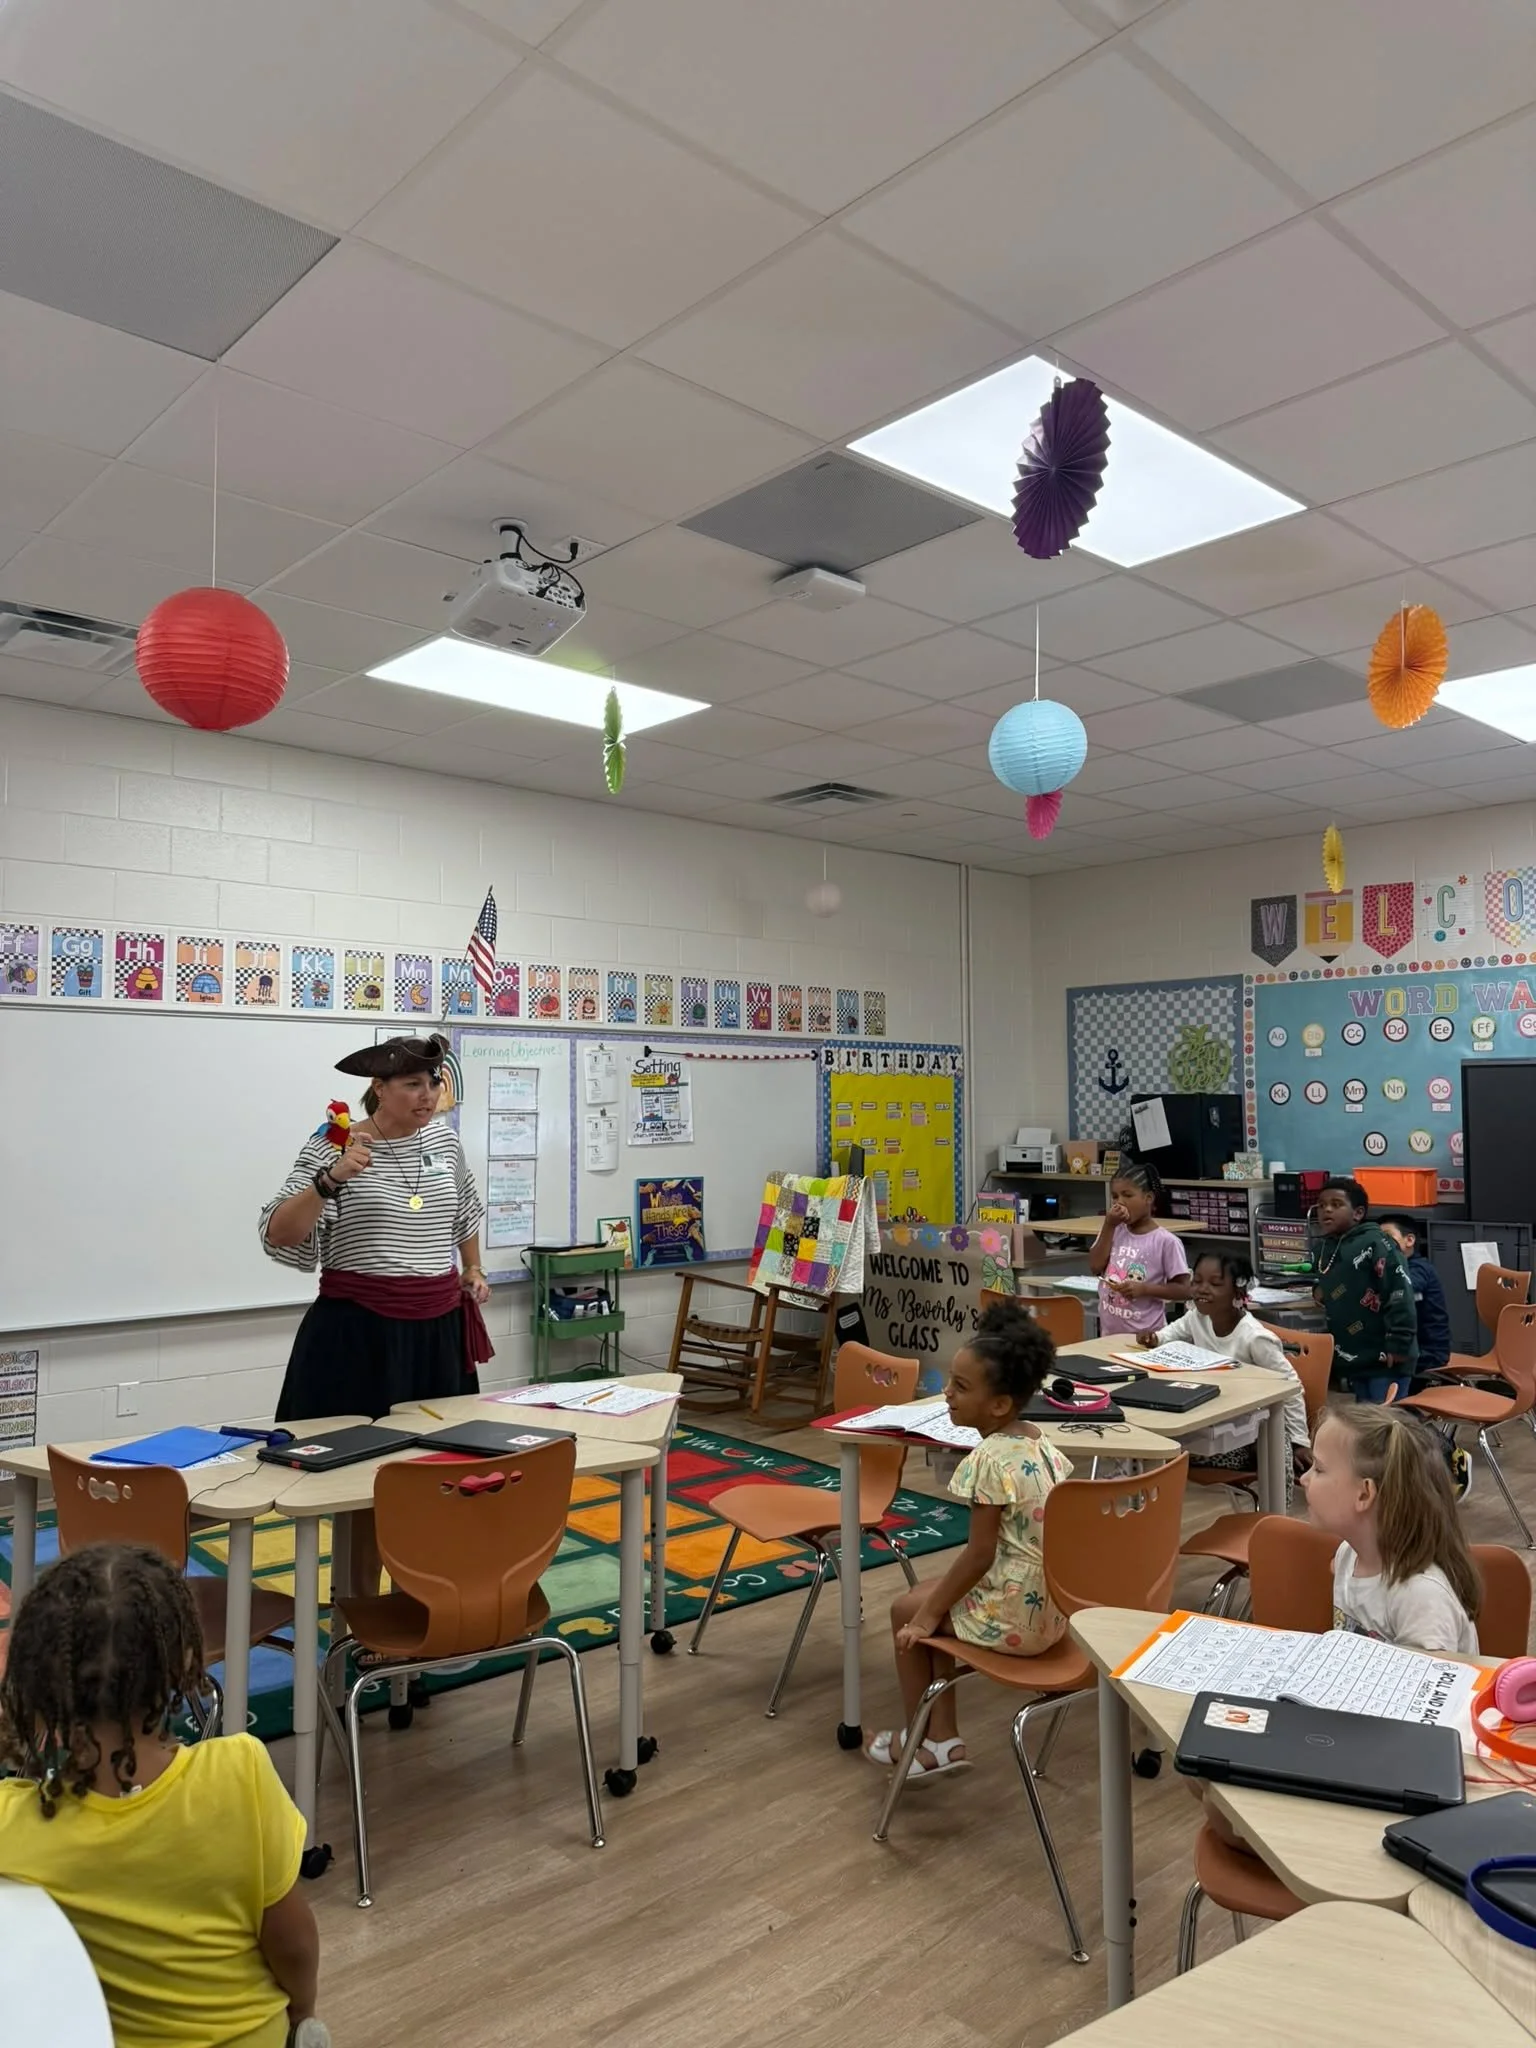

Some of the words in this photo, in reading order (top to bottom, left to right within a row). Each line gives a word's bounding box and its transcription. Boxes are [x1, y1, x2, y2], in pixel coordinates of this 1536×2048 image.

[62, 936, 94, 957] Gg
[125, 940, 155, 961] Hh
[194, 945, 208, 964] Ii
[251, 951, 268, 968] Jj
[301, 955, 326, 973] Kk
[357, 958, 372, 975] Ll
[401, 961, 426, 978] Mm
[449, 965, 470, 981] Nn
[493, 968, 513, 984] Oo
[536, 971, 553, 987] Pp
[11, 986, 27, 994] Fish
[78, 988, 92, 997] Gift
[614, 978, 631, 993] Rr
[651, 981, 667, 995] Ss
[687, 983, 703, 998] Tt
[719, 986, 736, 1000] Uu
[751, 987, 768, 1003] Vv
[782, 991, 799, 1005] Ww
[814, 993, 826, 1006] Xx
[841, 994, 855, 1008] Yy
[1349, 984, 1459, 1018] WORD
[869, 997, 881, 1010] Zz
[1346, 1028, 1361, 1039] Cc
[1388, 1024, 1405, 1035] Dd
[1434, 1023, 1449, 1035] Ee
[1477, 1022, 1491, 1033] Ff
[1270, 1031, 1285, 1041] Aa
[1306, 1031, 1321, 1040] Bb
[462, 1039, 510, 1063] Learning
[510, 1040, 563, 1062] Objectives
[824, 1049, 958, 1070] BIRTHDAY
[633, 1059, 681, 1080] Setting
[1273, 1088, 1287, 1098] Kk
[1311, 1087, 1322, 1098] Ll
[1345, 1086, 1364, 1096] Mm
[1387, 1084, 1403, 1094] Nn
[1431, 1083, 1449, 1094] Oo
[1367, 1139, 1384, 1150] Uu
[1414, 1135, 1430, 1147] Vv
[645, 1209, 671, 1221] Hands
[654, 1223, 689, 1238] These?
[1268, 1224, 1297, 1233] MONDAY
[869, 1253, 943, 1283] WELCOME
[948, 1260, 969, 1286] TO
[862, 1285, 893, 1319] Ms
[897, 1289, 980, 1333] Beverly's
[888, 1322, 940, 1352] CLASS
[746, 1454, 776, 1469] Xx
[892, 1497, 919, 1512] Zz
[897, 1525, 944, 1540] Aa
[1436, 1671, 1457, 1689] ROLL
[1428, 1690, 1448, 1707] AND
